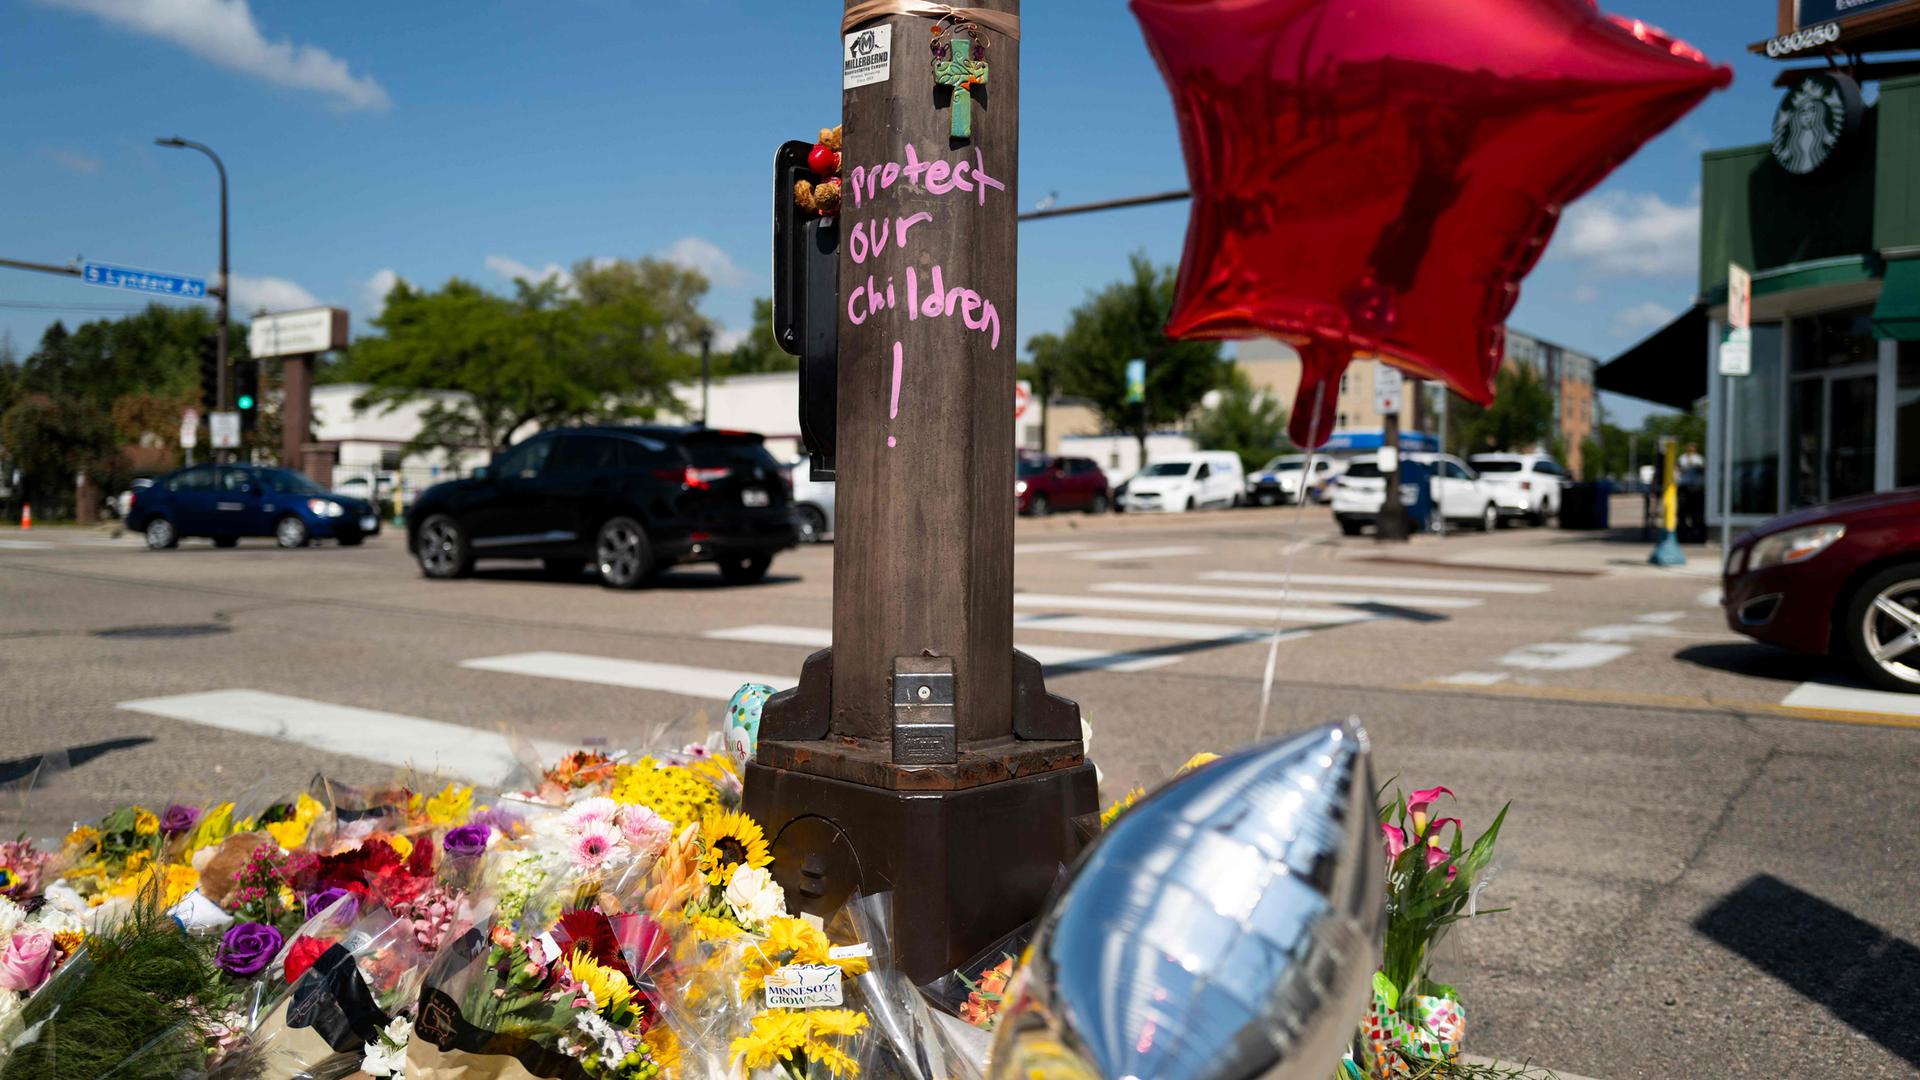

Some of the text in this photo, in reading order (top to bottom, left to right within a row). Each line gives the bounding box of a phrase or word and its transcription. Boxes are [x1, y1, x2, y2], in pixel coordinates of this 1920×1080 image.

[845, 51, 888, 70] MILLERBERND
[850, 143, 1005, 208] protect
[850, 211, 933, 264] our
[88, 265, 99, 282] S
[105, 268, 174, 292] Lyndale
[887, 341, 903, 448] !
[768, 983, 838, 996] MINNESOTA
[770, 995, 816, 1005] GROWN
